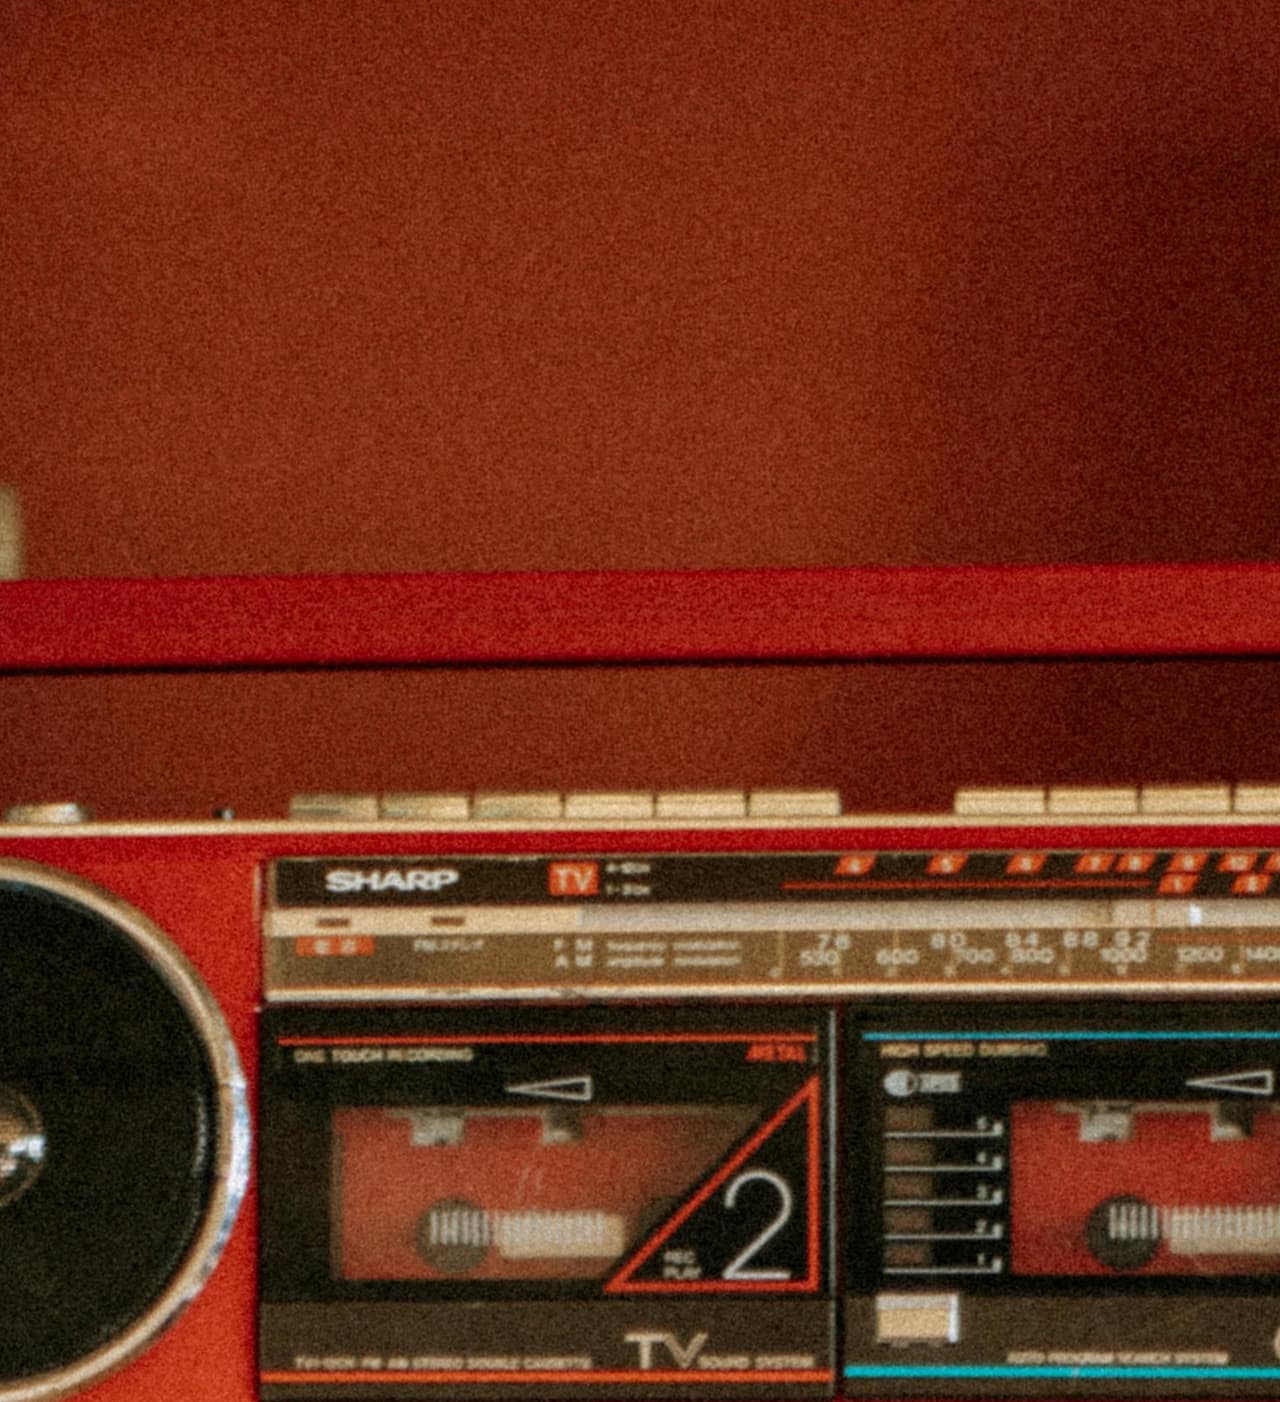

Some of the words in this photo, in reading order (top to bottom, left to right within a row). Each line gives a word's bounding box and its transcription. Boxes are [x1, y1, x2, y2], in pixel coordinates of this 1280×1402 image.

[324, 868, 460, 893] SHARP
[554, 867, 595, 893] TV
[874, 948, 920, 965] 600
[955, 947, 996, 964] 700
[1100, 945, 1148, 963] 1000
[1176, 945, 1225, 962] 1200
[330, 1047, 384, 1063] TOUCH
[386, 1046, 475, 1063] RECORDING
[878, 1042, 920, 1059] HIGH
[922, 1042, 975, 1058] SPEED
[722, 1168, 794, 1280] 2
[662, 1249, 698, 1265] REC
[662, 1265, 703, 1280] PLAY
[623, 1330, 710, 1370] TV
[755, 1354, 815, 1369] SYSTEM
